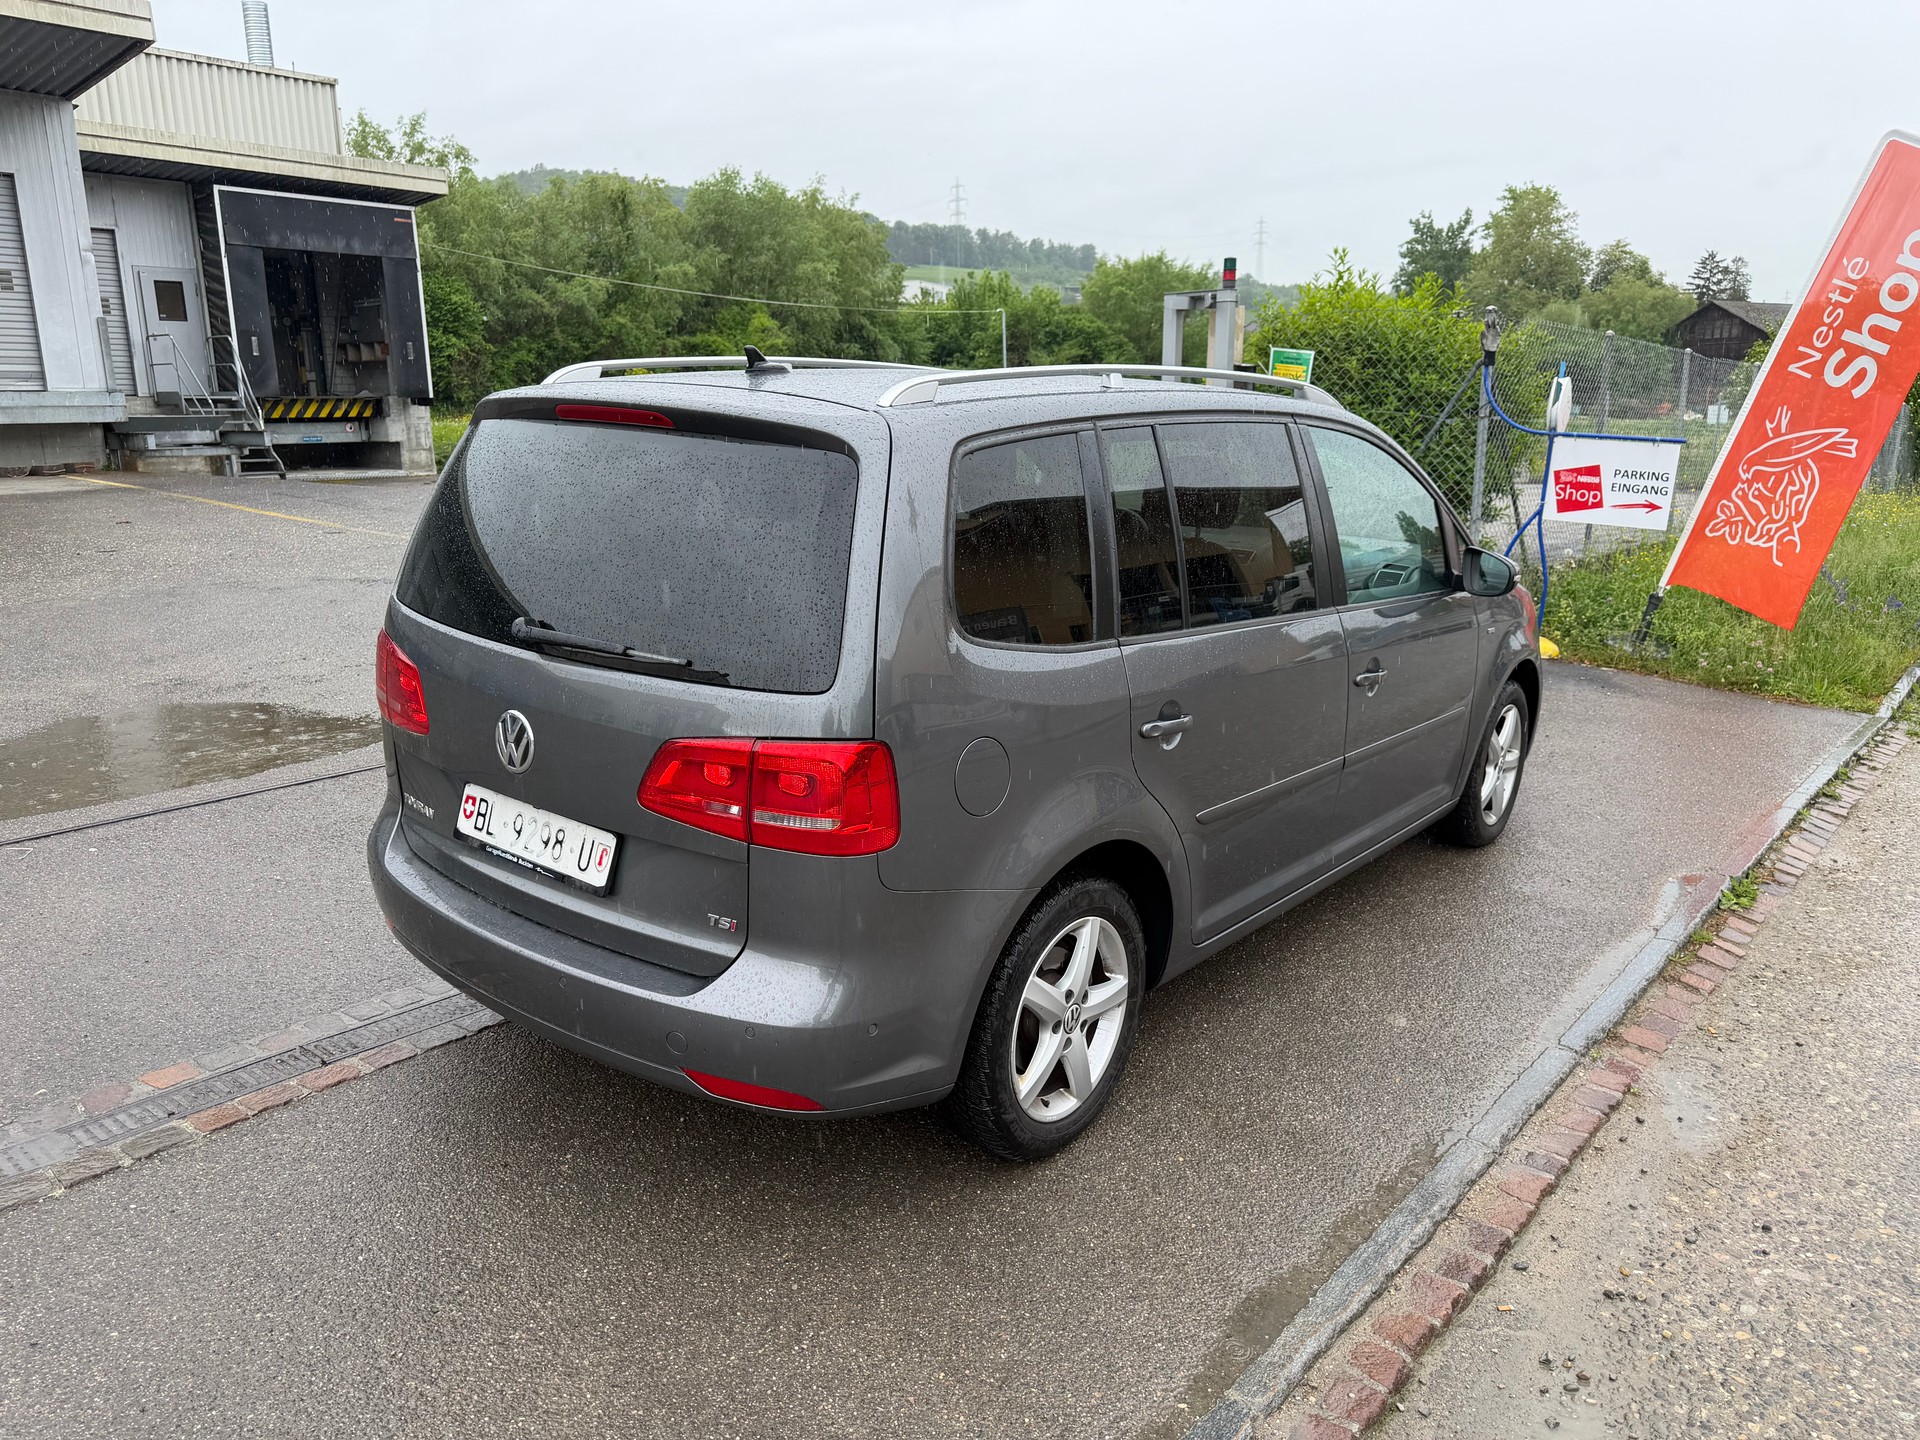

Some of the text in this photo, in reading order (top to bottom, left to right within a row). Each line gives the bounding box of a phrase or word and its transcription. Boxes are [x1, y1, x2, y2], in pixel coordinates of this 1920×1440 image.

[1787, 256, 1870, 379] Nestlé
[1613, 469, 1670, 482] PARKING
[1555, 483, 1600, 506] Shop
[1611, 482, 1669, 496] EINGANG
[474, 797, 596, 872] BL 9298 U
